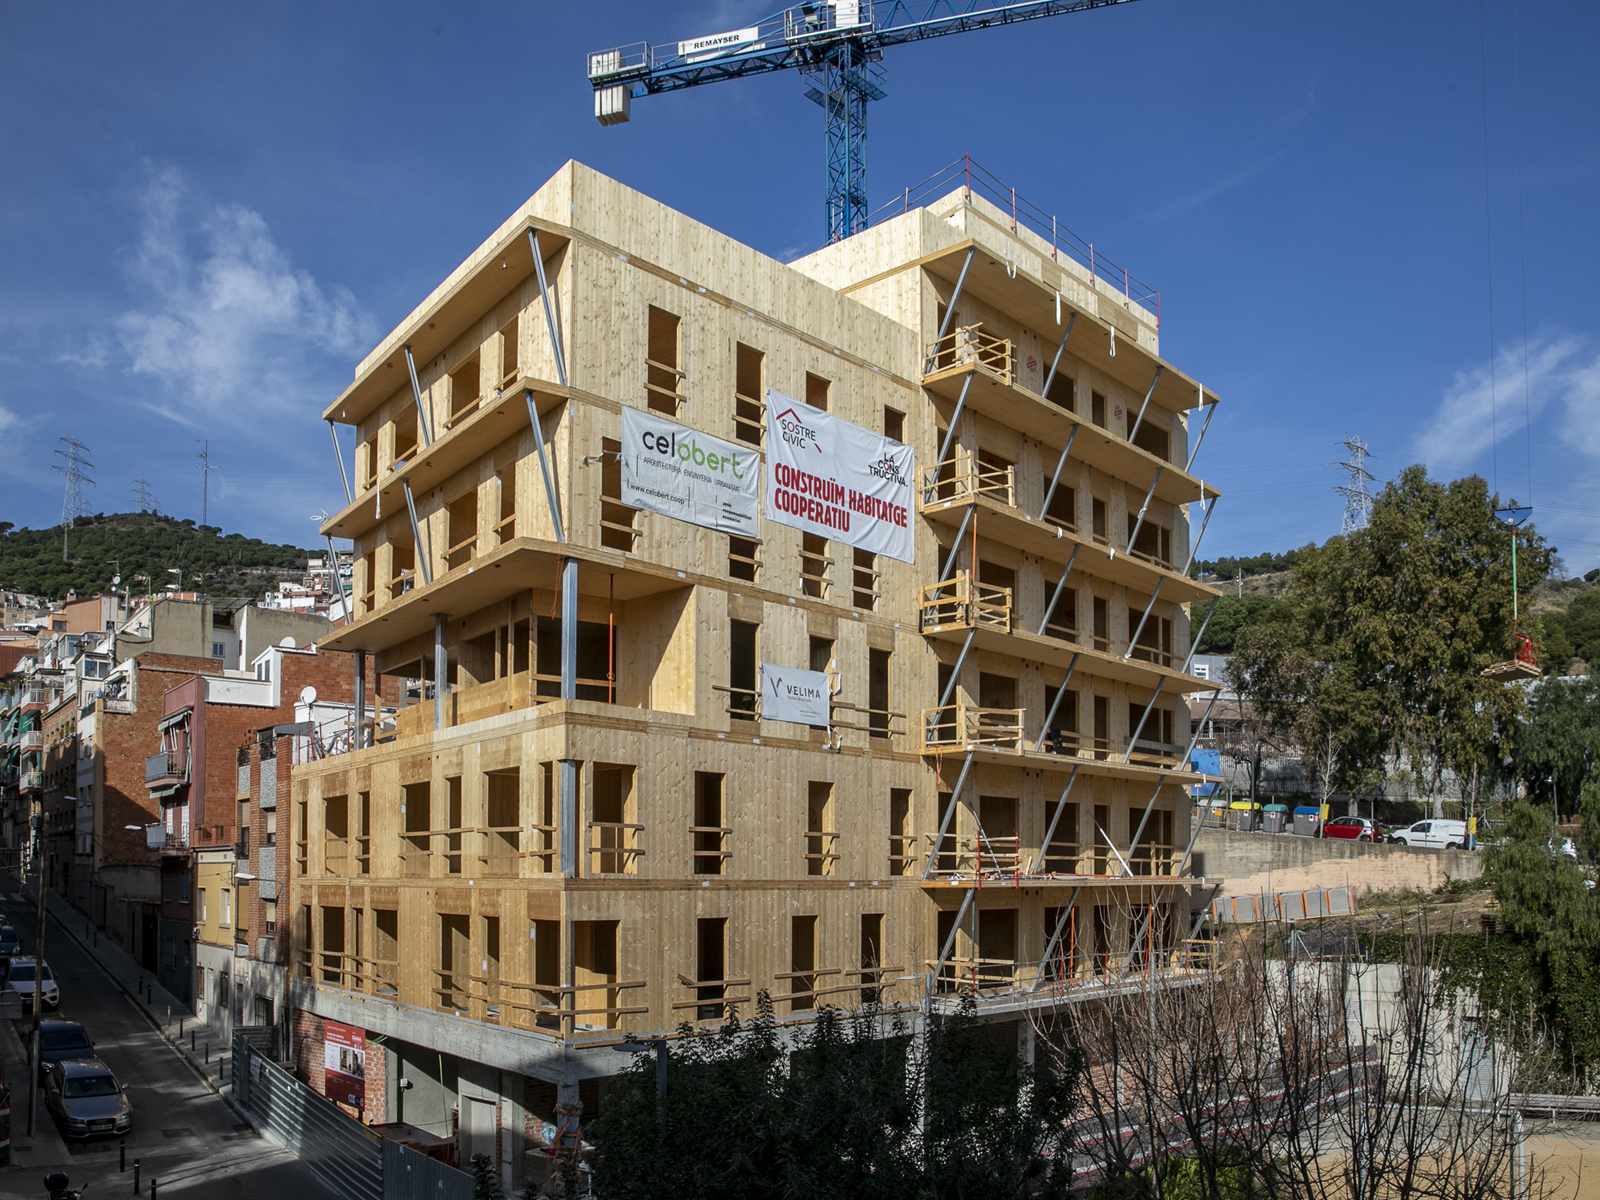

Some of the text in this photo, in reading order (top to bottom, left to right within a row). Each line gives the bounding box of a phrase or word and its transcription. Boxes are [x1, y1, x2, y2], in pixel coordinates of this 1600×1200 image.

[694, 34, 740, 49] REMAYSER
[781, 419, 816, 442] SOSTRE
[642, 431, 744, 479] celobert
[883, 452, 895, 464] LA
[643, 456, 741, 492] ARQUITECTURA ENGINYERIA URBANISME
[877, 459, 900, 475] CONS
[629, 483, 685, 505] www.celobert.coop
[774, 462, 907, 528] CONSTRUÏM HABITATGE
[774, 487, 850, 533] COOPERATIU
[786, 684, 821, 699] VELIMA
